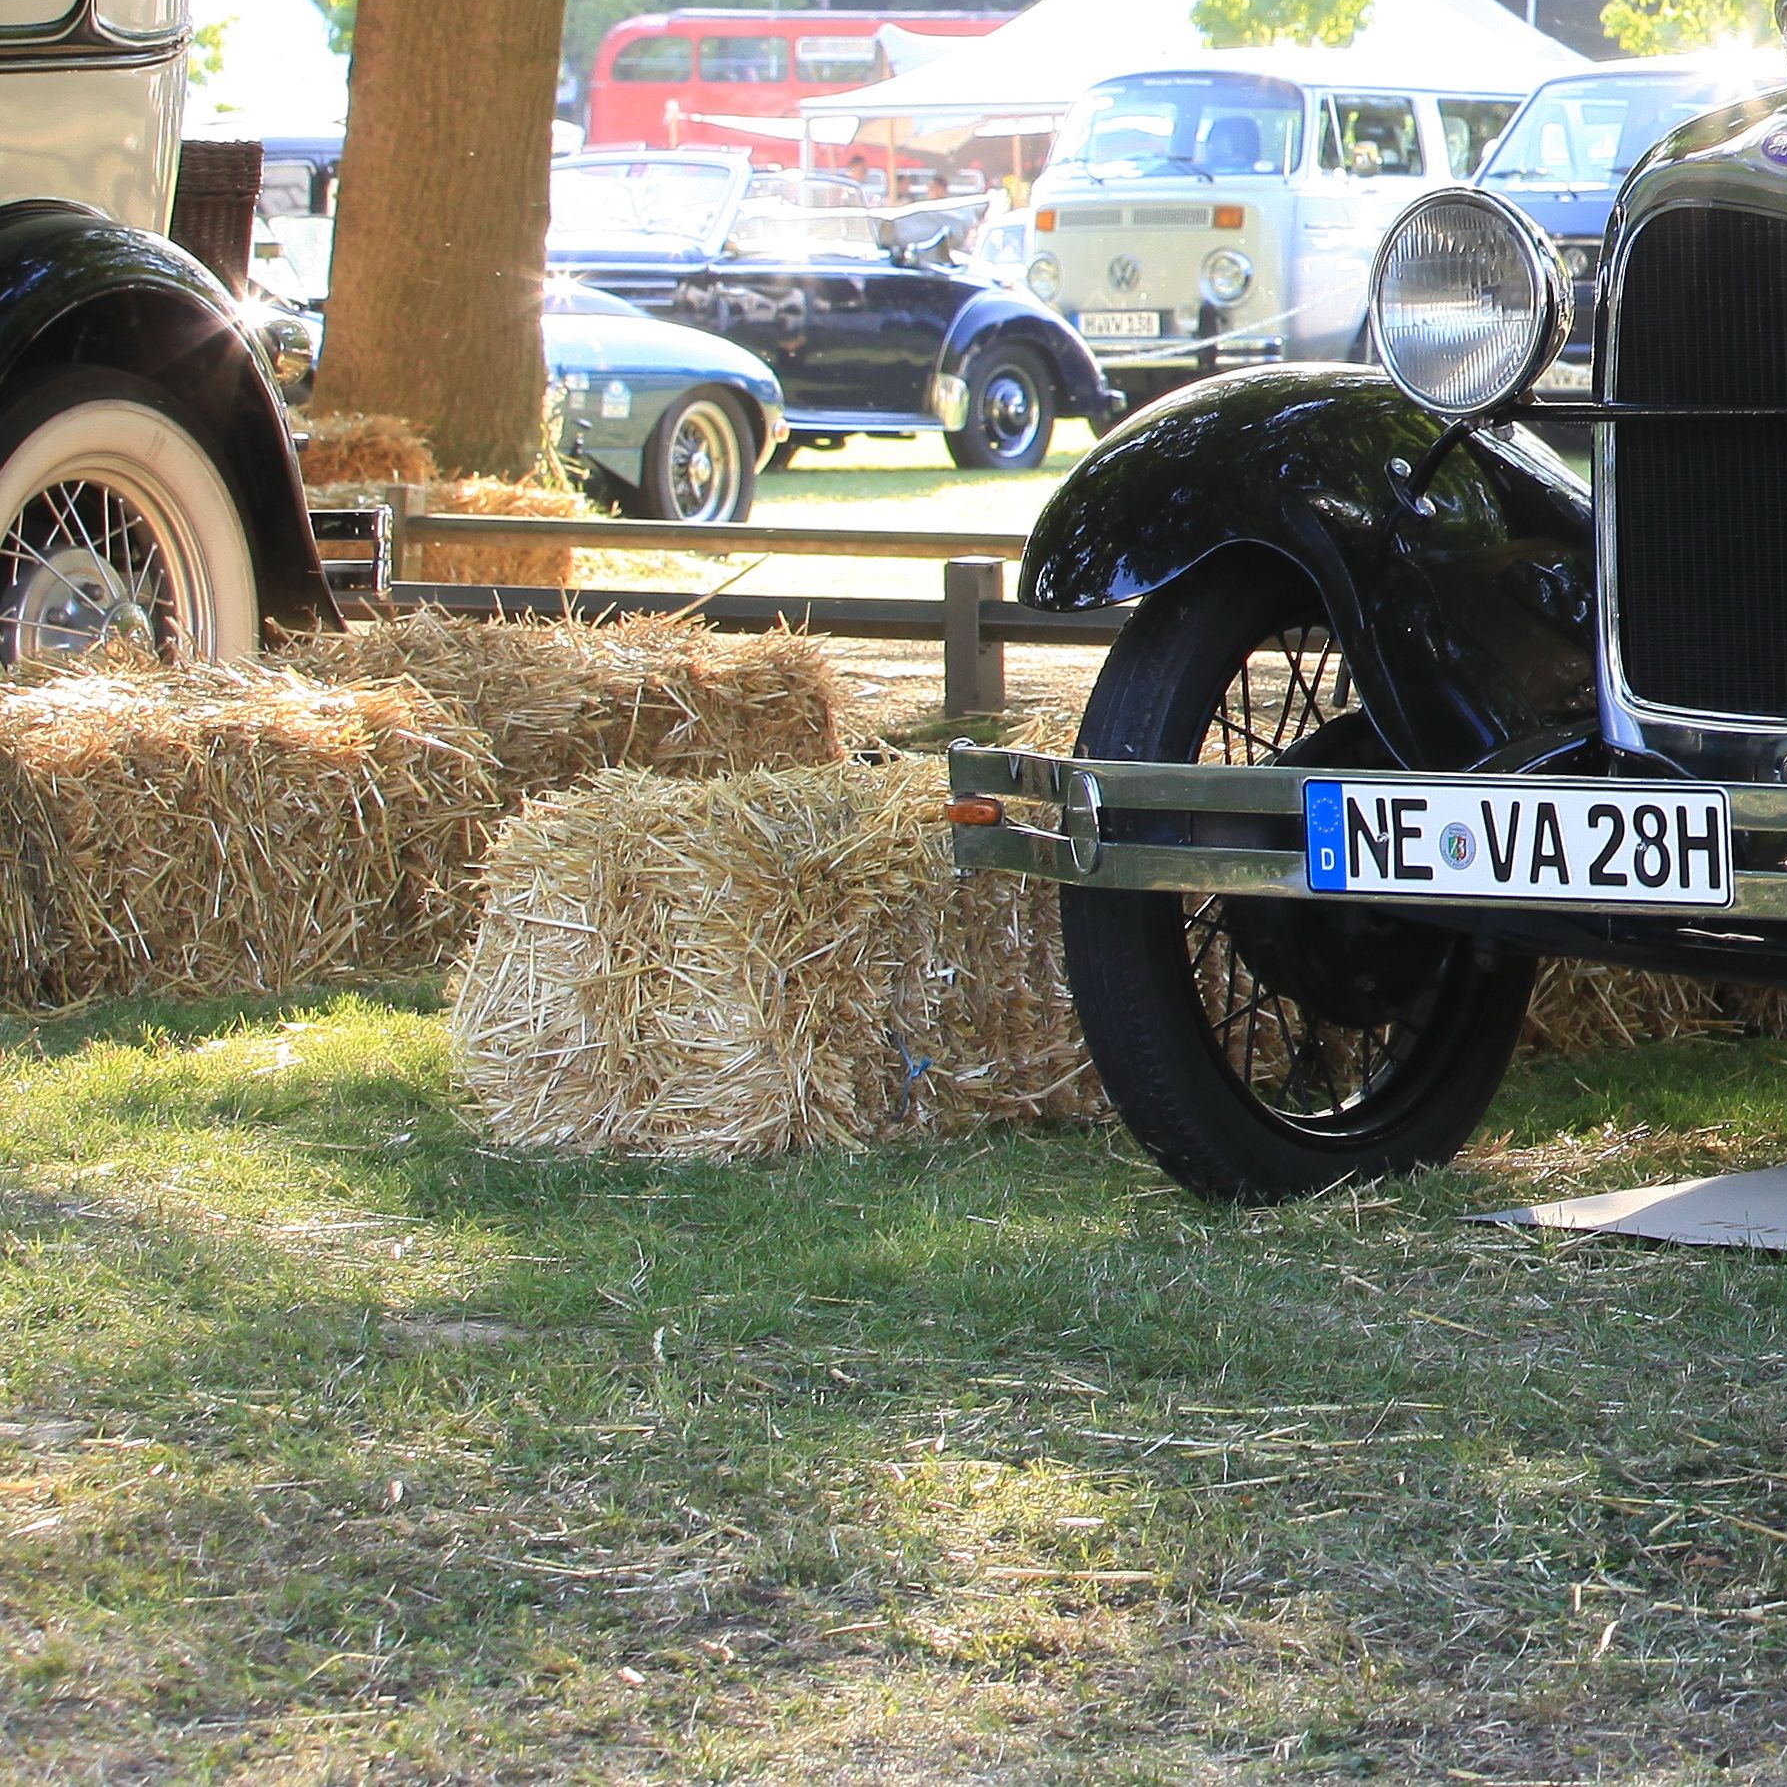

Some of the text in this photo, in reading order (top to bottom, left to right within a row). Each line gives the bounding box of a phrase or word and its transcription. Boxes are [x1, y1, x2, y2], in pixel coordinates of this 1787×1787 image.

[1320, 846, 1335, 872] D
[1346, 797, 1721, 889] NE VA 28H
